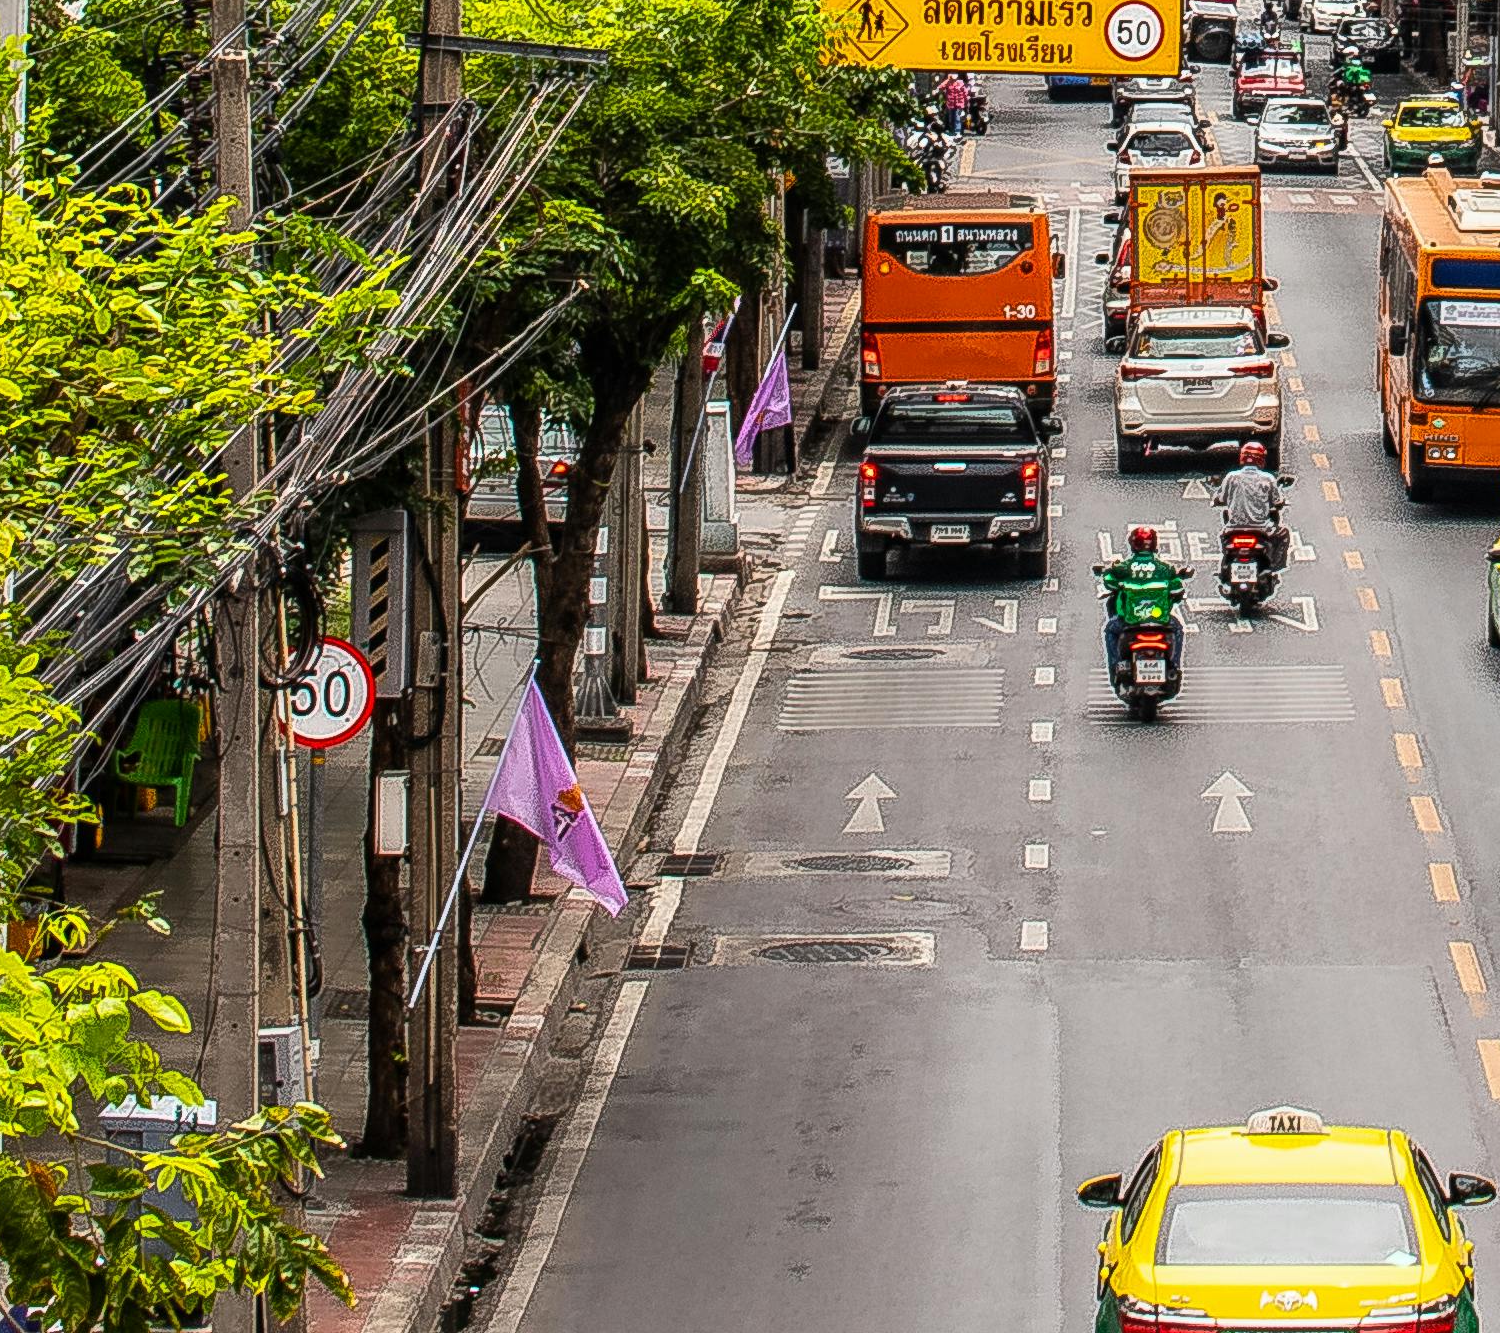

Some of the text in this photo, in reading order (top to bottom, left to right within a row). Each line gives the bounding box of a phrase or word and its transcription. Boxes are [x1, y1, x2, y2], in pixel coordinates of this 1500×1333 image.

[1117, 19, 1152, 46] 50
[940, 31, 1073, 64] เขตโรงเรียน
[1003, 304, 1036, 319] 1-30
[1268, 1115, 1302, 1133] TAXI
